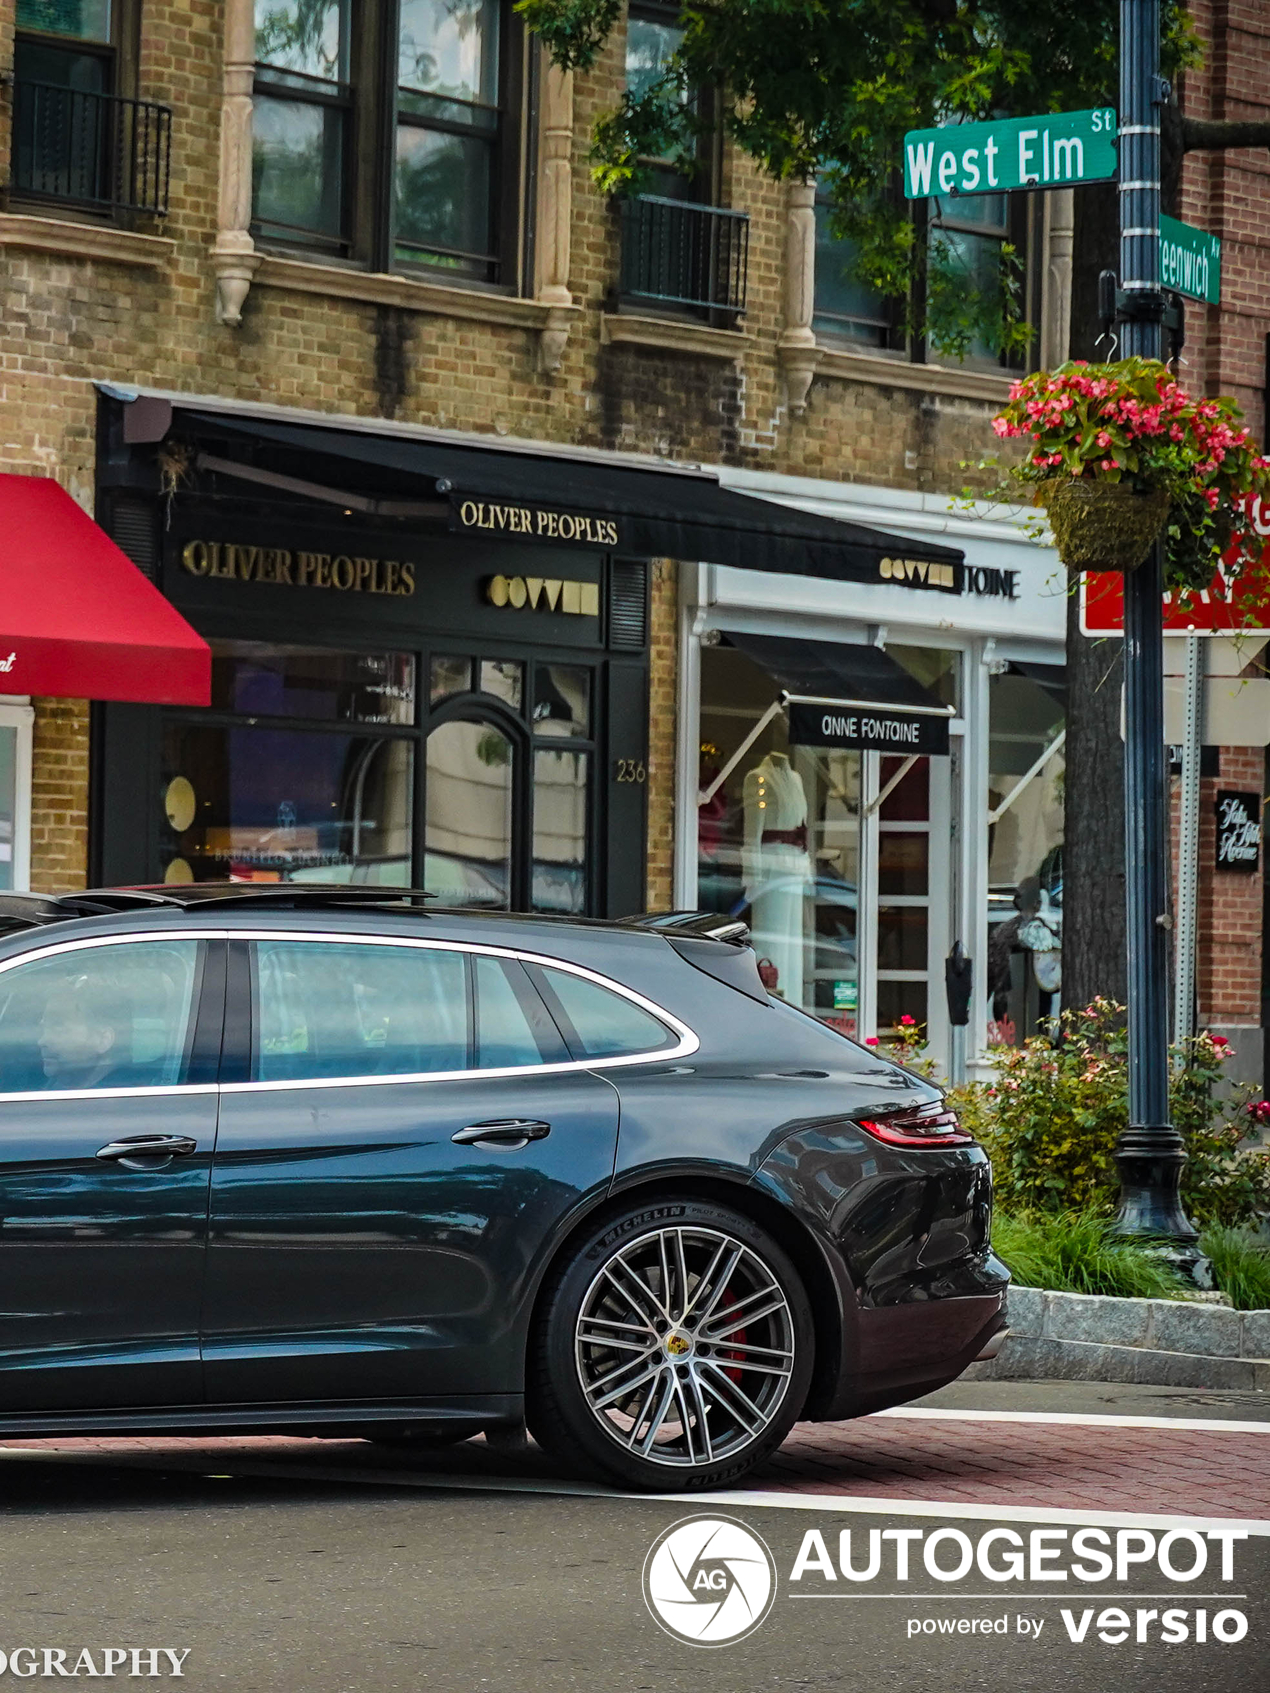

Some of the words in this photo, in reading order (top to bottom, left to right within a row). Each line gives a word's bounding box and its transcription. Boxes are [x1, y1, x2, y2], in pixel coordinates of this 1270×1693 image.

[906, 134, 999, 196] West
[1018, 128, 1084, 184] Elm
[1091, 111, 1111, 132] St
[1159, 238, 1209, 299] eenwich
[460, 501, 533, 535] OLIVER
[536, 511, 618, 545] PEOPLES
[182, 540, 293, 586] OLIVER
[296, 551, 415, 596] PEOPLES
[617, 759, 646, 783] 236
[605, 1206, 681, 1244] MICHELIN
